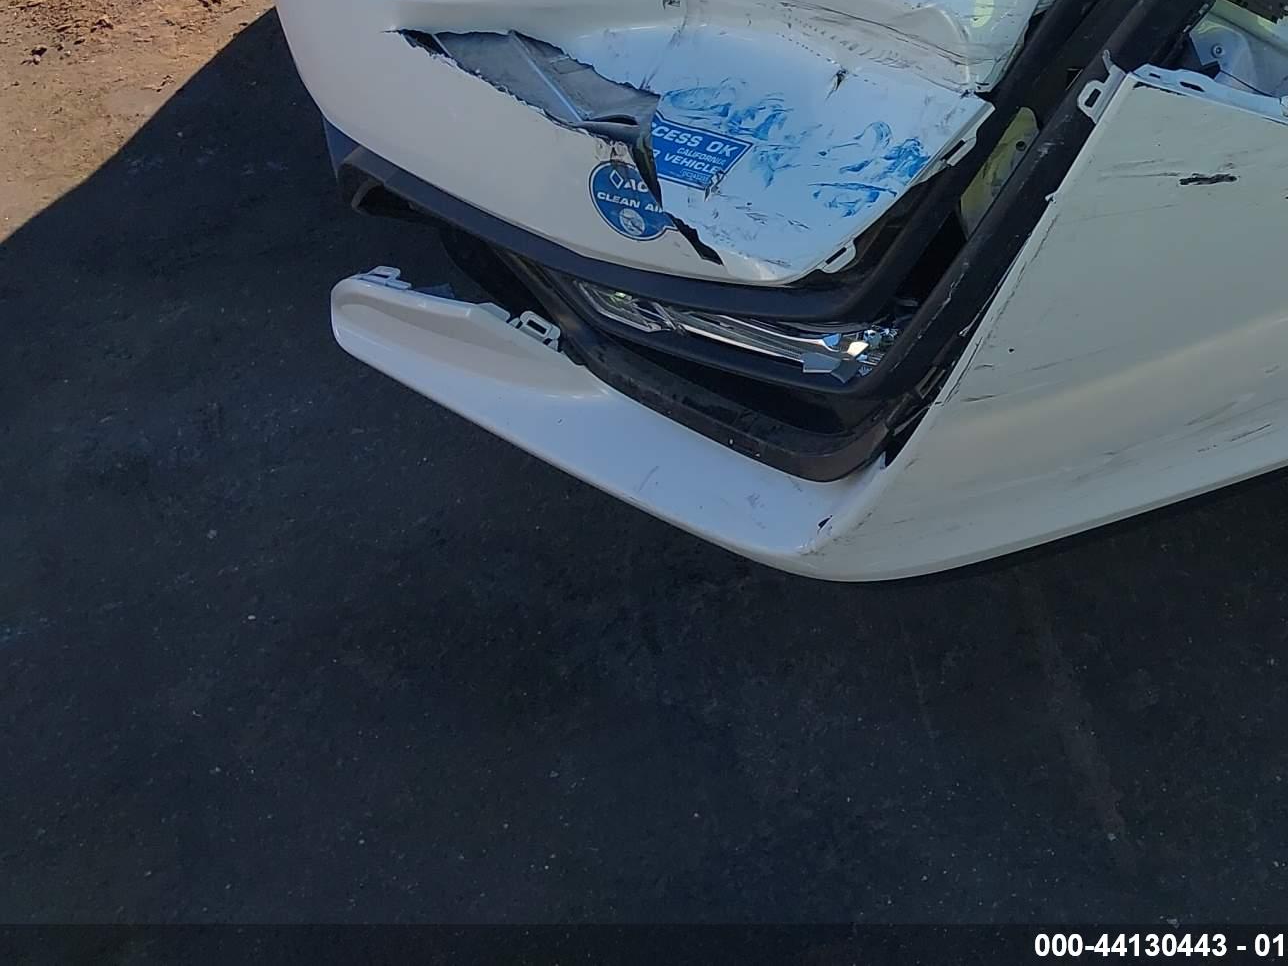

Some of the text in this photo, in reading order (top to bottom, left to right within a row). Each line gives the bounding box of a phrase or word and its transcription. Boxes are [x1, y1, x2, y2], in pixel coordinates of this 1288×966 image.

[652, 122, 738, 158] CESS OK
[676, 147, 727, 165] CALIFORNIA
[596, 191, 641, 209] CLEAN
